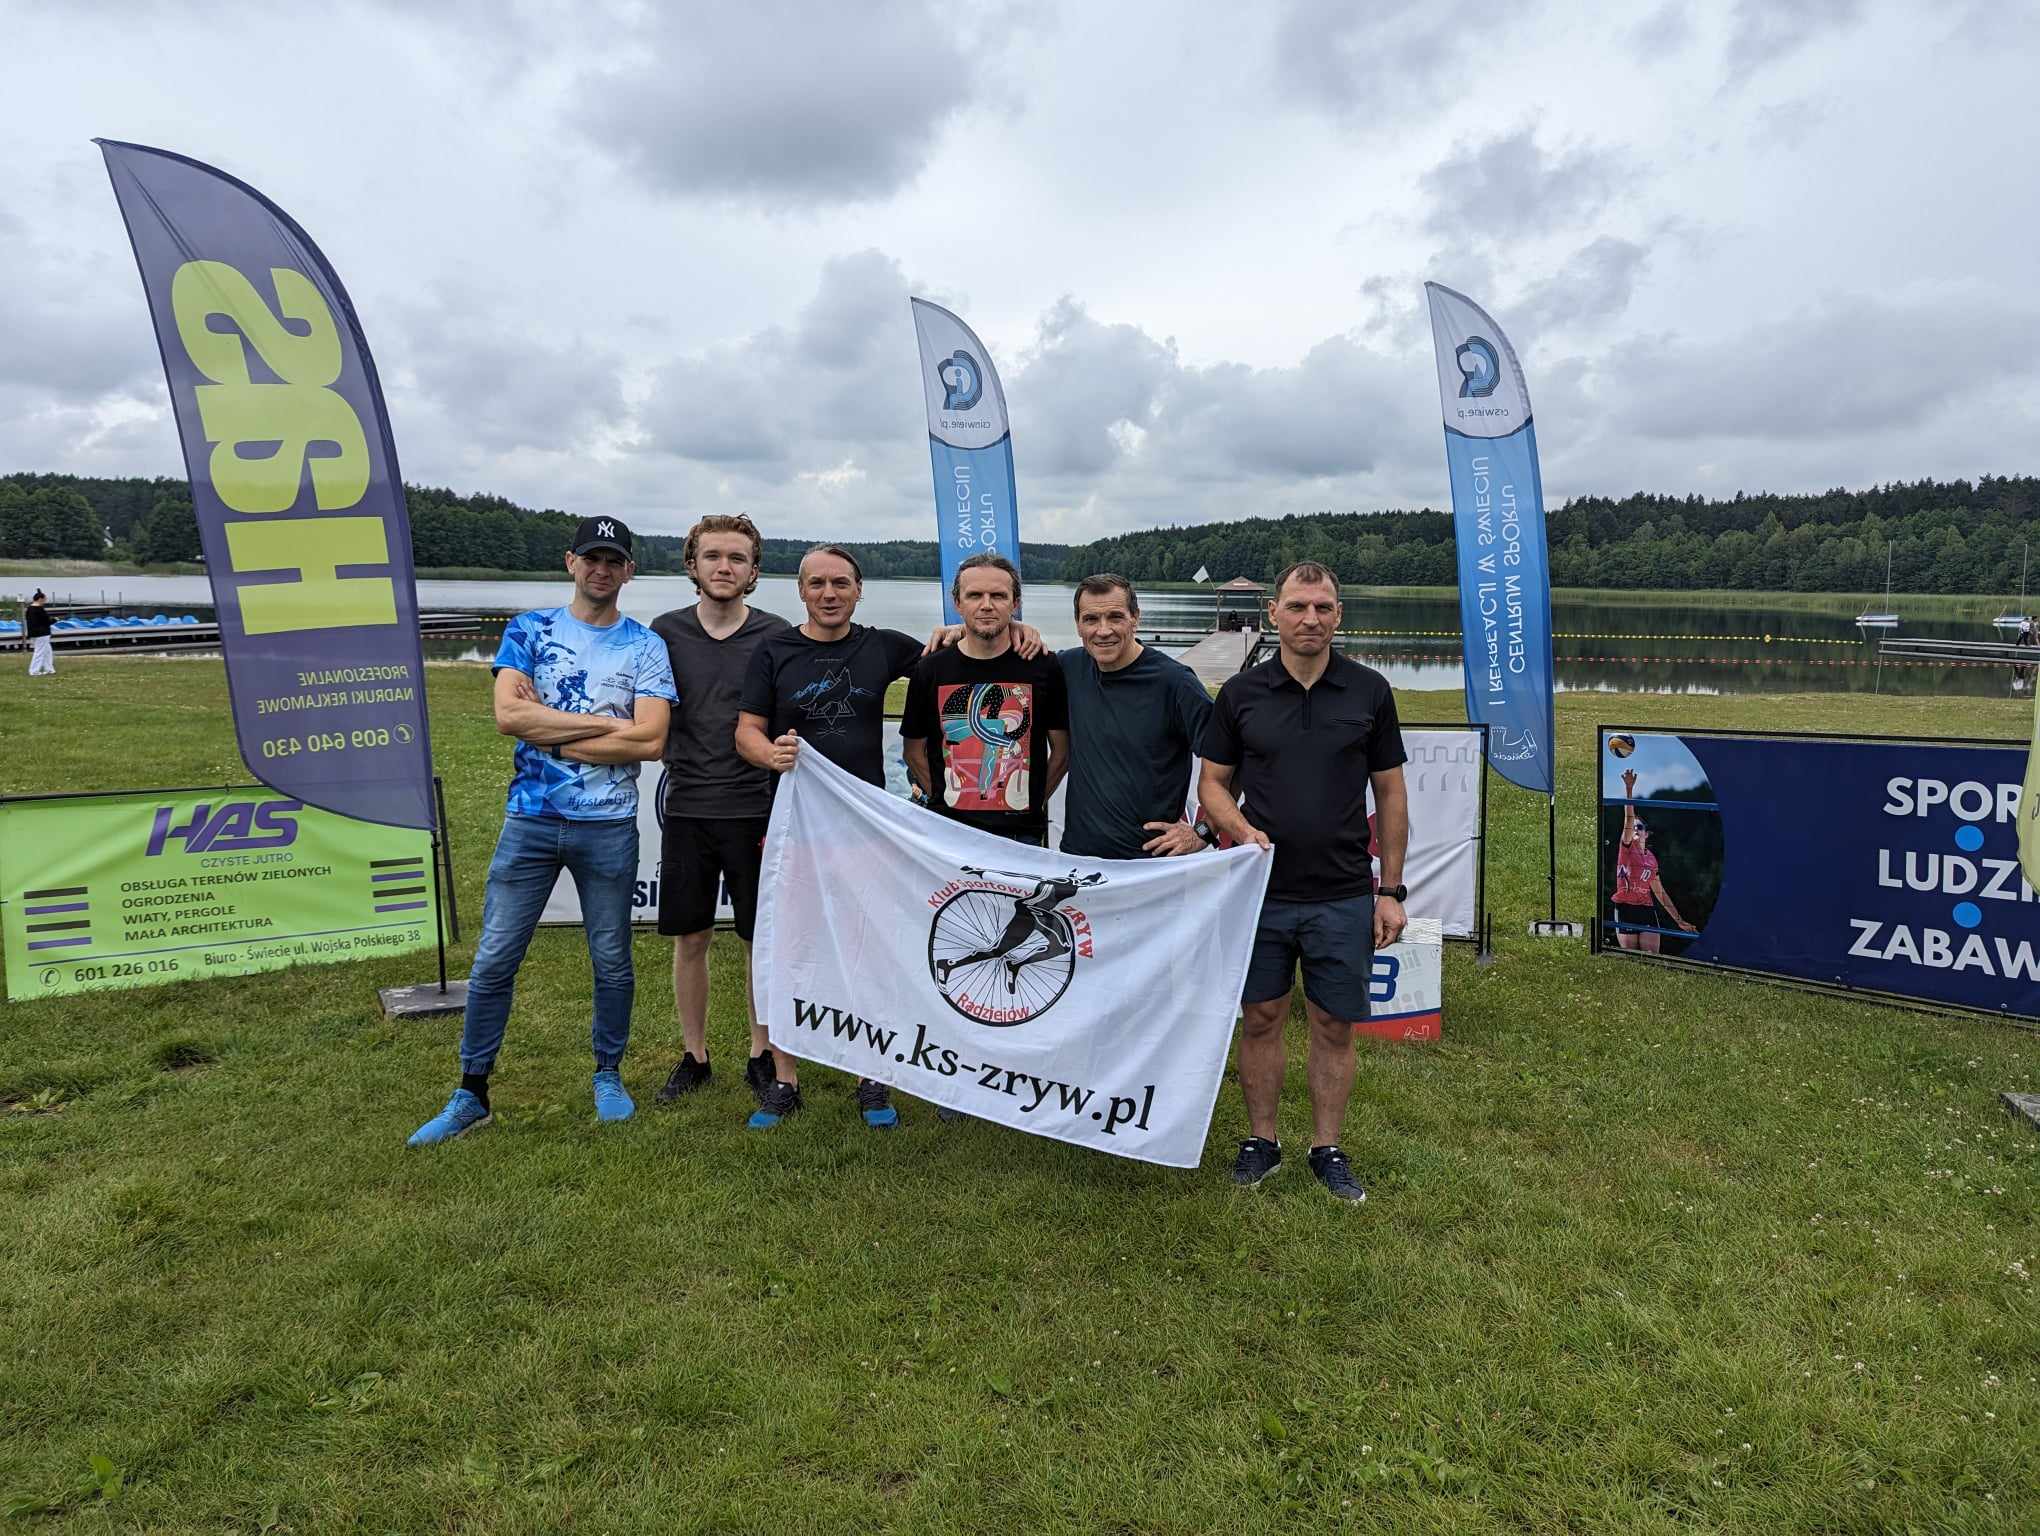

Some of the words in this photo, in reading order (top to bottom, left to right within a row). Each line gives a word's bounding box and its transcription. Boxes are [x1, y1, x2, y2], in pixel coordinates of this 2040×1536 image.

[1882, 777, 2023, 823] SPOR
[145, 800, 304, 856] HAS
[201, 855, 250, 869] CZYSTE
[252, 852, 294, 866] JUTRO
[120, 877, 188, 893] OBSŁUGA
[191, 871, 258, 887] TERENÓW
[262, 866, 333, 881] ZIELONYCH
[1878, 849, 2040, 903] LUDZI
[122, 891, 215, 909] OGRODZENIA
[928, 880, 960, 908] Klub
[123, 912, 172, 926] WIATY,
[175, 905, 236, 919] PERGOLE
[125, 928, 167, 941] MAŁA
[171, 917, 273, 937] ARCHITEKTURA
[1062, 906, 1093, 958] ZRYW
[204, 953, 237, 966] Biuro
[247, 944, 291, 961] Świecie
[293, 943, 308, 955] ul.
[311, 941, 351, 954] Wojska
[353, 934, 405, 949] Polskiego
[407, 930, 421, 941] 38
[74, 966, 107, 982] 601
[111, 962, 143, 977] 226
[148, 959, 179, 973] 016
[792, 998, 1155, 1135] www.ks-zryw.pl
